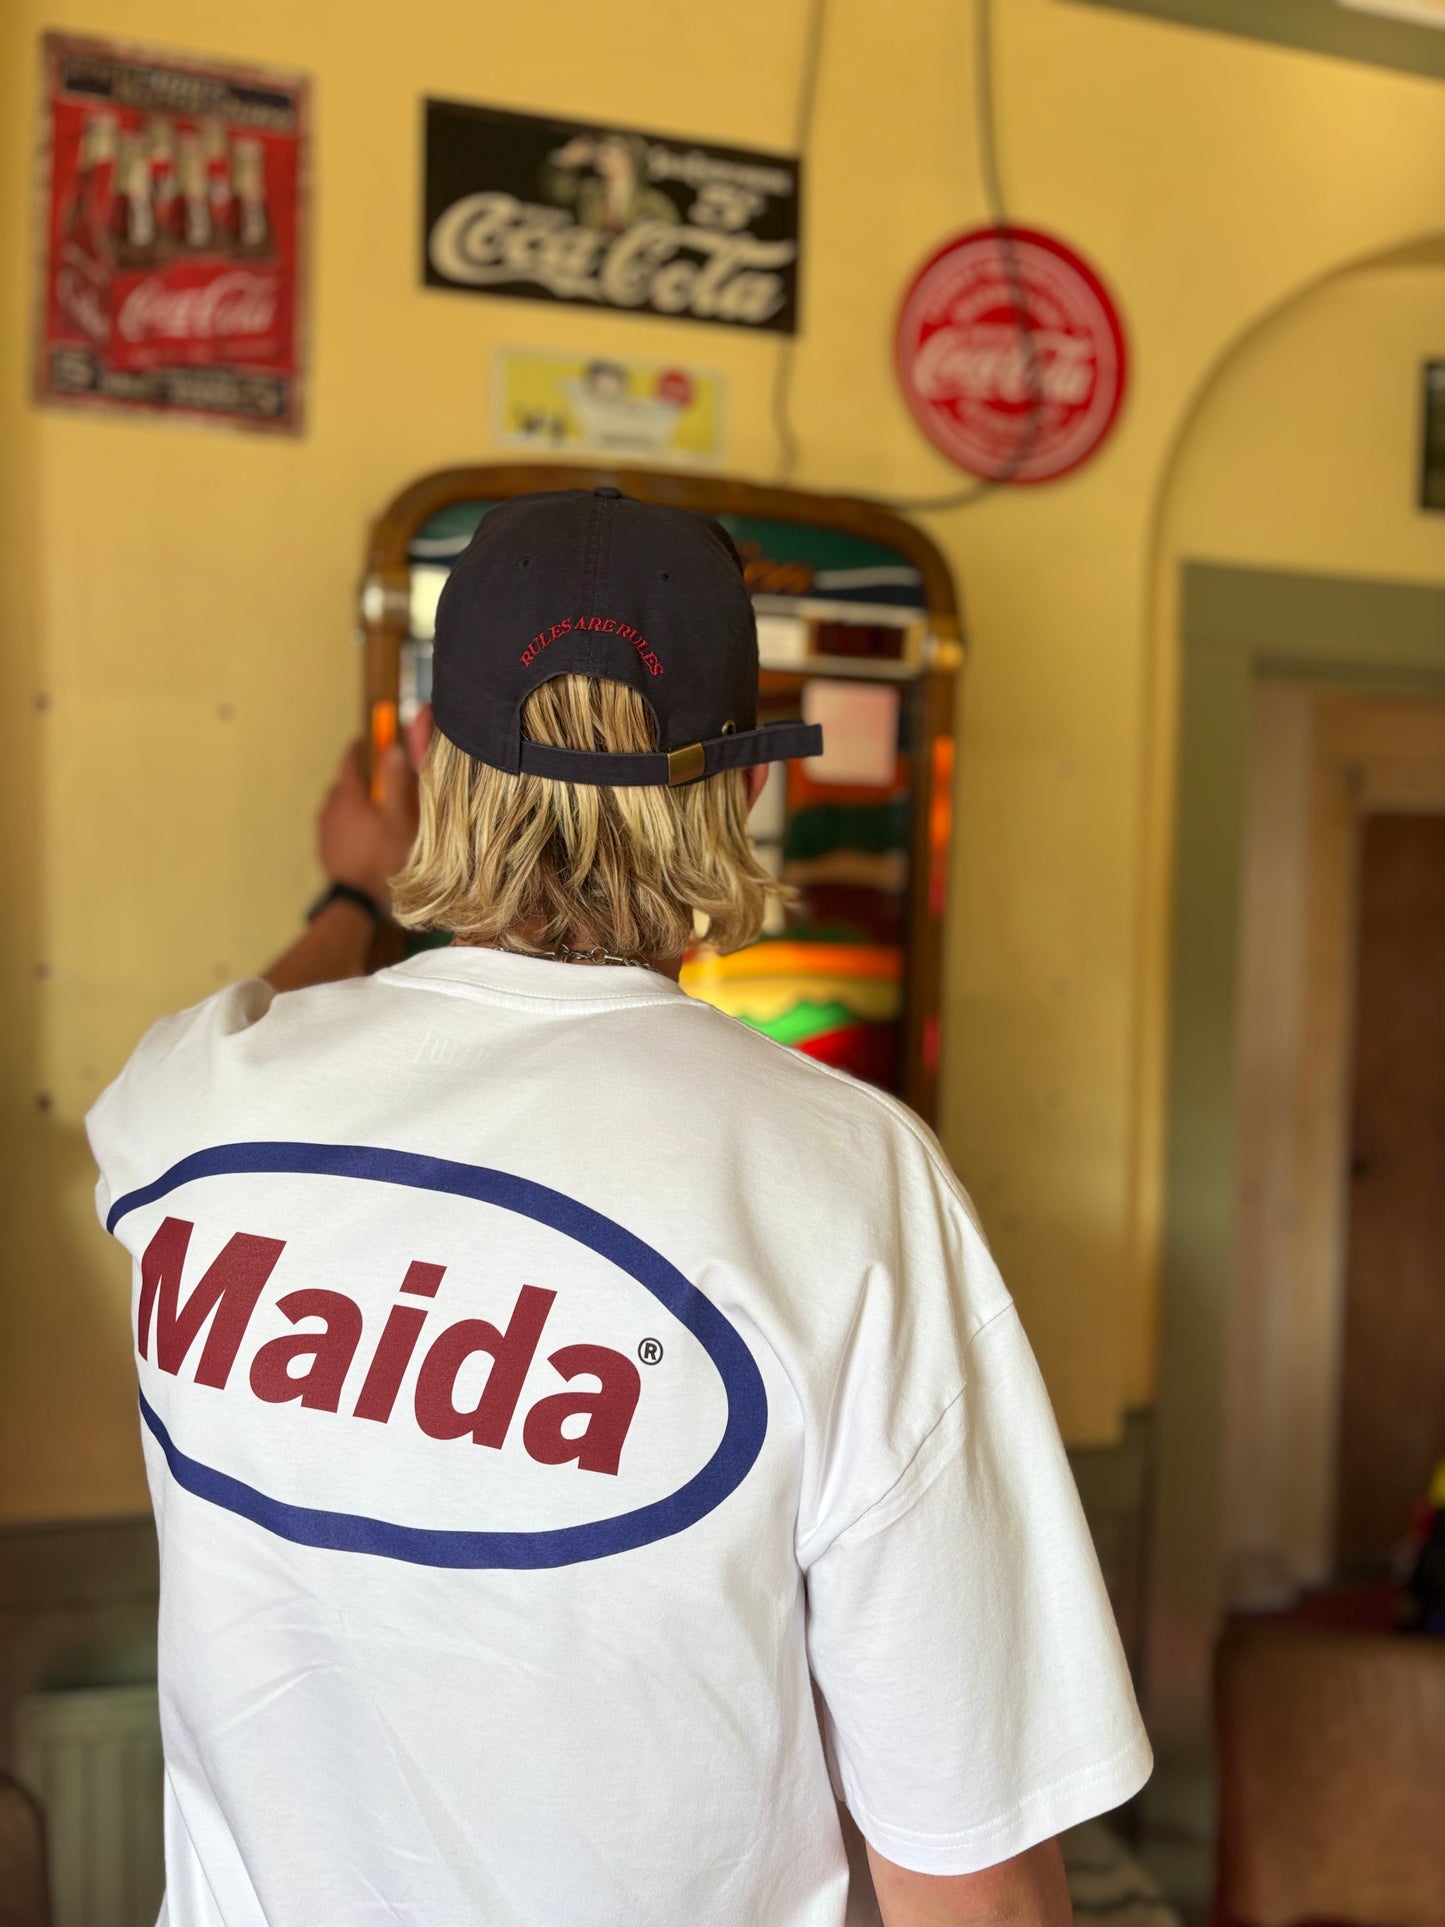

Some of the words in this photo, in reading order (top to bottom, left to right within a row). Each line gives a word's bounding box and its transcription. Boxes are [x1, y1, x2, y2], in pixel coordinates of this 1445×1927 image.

[520, 618, 571, 667] RULES
[575, 616, 617, 632] ARE
[616, 623, 664, 677] RULES
[138, 1216, 641, 1476] Maida
